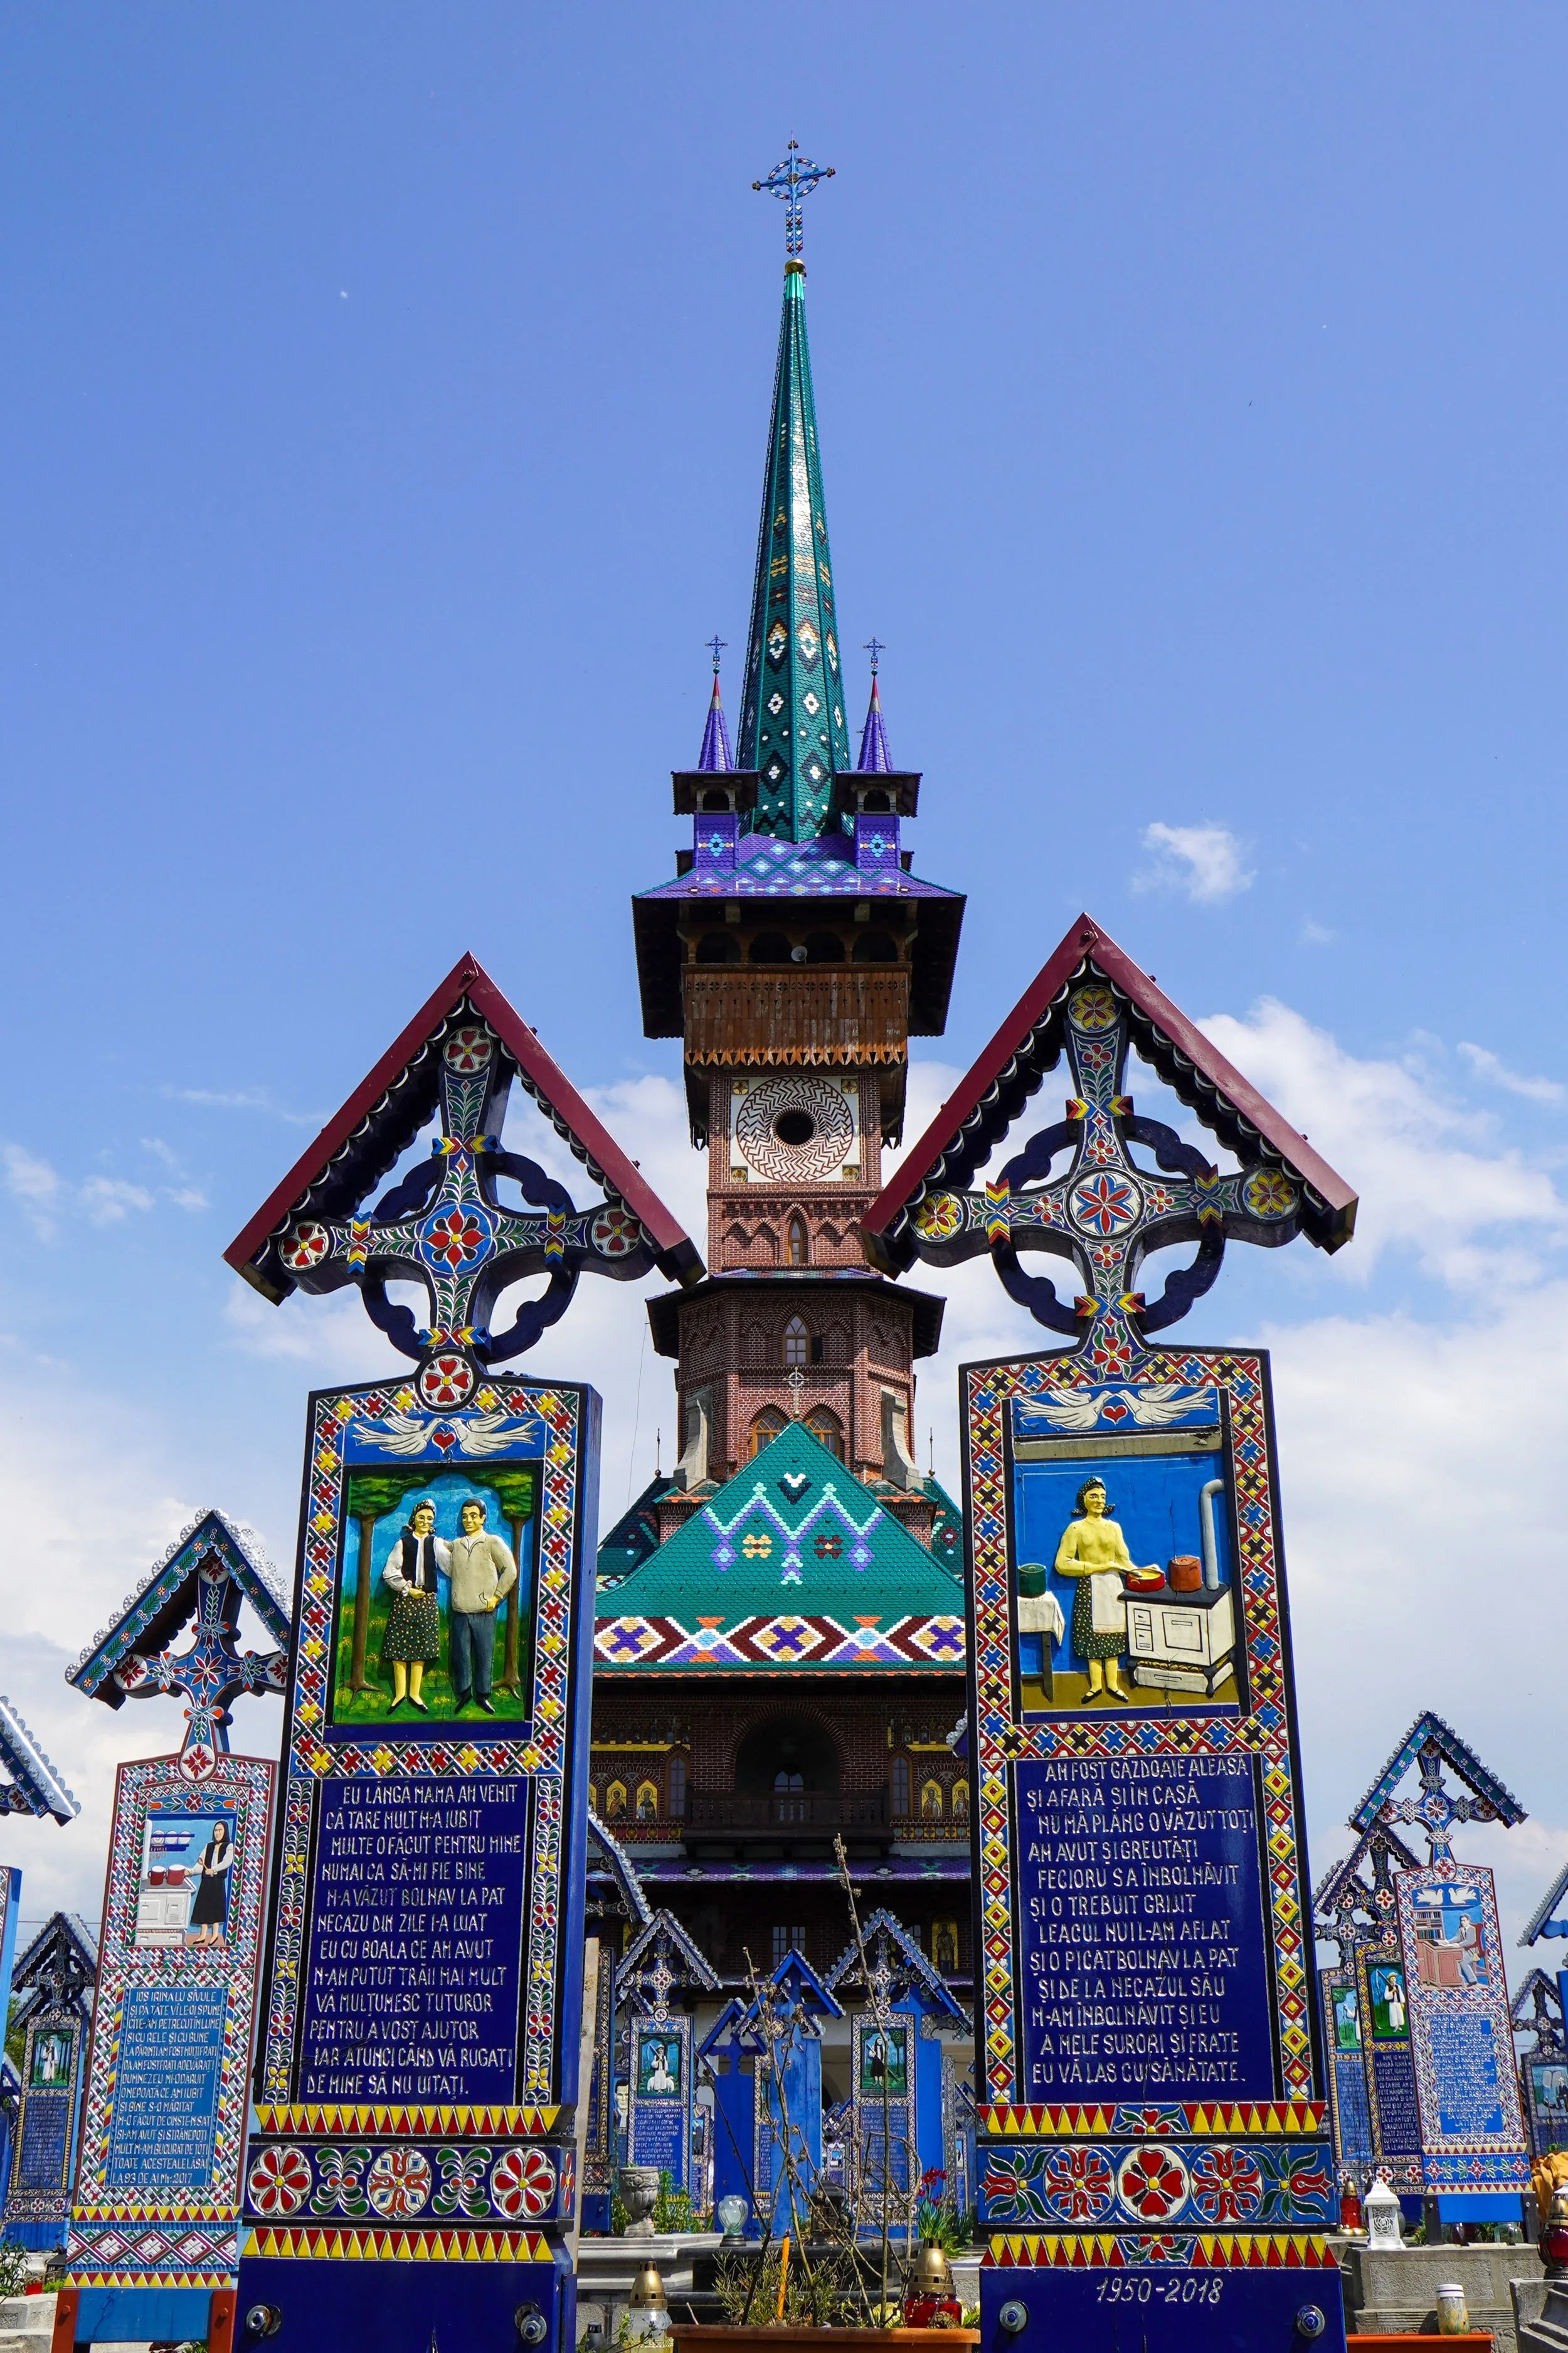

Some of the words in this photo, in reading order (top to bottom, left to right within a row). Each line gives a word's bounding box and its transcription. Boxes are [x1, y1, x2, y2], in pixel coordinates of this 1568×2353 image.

[1045, 1762, 1067, 1782] AM
[1072, 1761, 1107, 1781] FOST
[344, 1786, 361, 1805] EU
[415, 1785, 455, 1803] MAMA
[457, 1784, 475, 1803] AM
[480, 1784, 517, 1802] VENIT
[1153, 1780, 1200, 1805] CASĂ
[326, 1807, 344, 1829] CĂ
[348, 1811, 381, 1829] TARE
[384, 1810, 418, 1829] MULT
[420, 1810, 443, 1828] M-A
[446, 1810, 482, 1828] IUBIT
[1037, 1814, 1060, 1834] NU
[1064, 1810, 1089, 1834] MĂ
[1162, 1807, 1216, 1830] VĂZUT
[1218, 1809, 1254, 1833] TOȚI
[331, 1837, 374, 1856] MULTE
[388, 1832, 431, 1854] FĂCUT
[435, 1835, 485, 1854] PENTRU
[489, 1834, 521, 1854] MINE
[1027, 1842, 1052, 1862] AM
[1055, 1842, 1098, 1861] AVUT
[1102, 1841, 1118, 1864] ȘI
[322, 1862, 363, 1881] NUMAI
[367, 1862, 384, 1881] CA
[432, 1861, 451, 1880] FIE
[455, 1862, 485, 1880] BINE
[1038, 1867, 1106, 1889] FECIORU
[402, 1888, 456, 1906] BOLNAV
[461, 1887, 478, 1906] LA
[481, 1887, 506, 1906] PAT
[1068, 1894, 1138, 1916] TREBUIT
[317, 1914, 368, 1933] NECAZU
[373, 1914, 394, 1932] DIN
[399, 1914, 426, 1932] ZILE
[453, 1913, 488, 1932] LUAT
[1039, 1923, 1101, 1943] LEACUL
[1180, 1920, 1231, 1941] AFLAT
[320, 1940, 337, 1959] EU
[341, 1940, 358, 1958] CU
[362, 1940, 408, 1959] BOALA
[411, 1940, 428, 1958] CE
[432, 1940, 452, 1958] AM
[455, 1939, 494, 1959] AVUT
[1066, 1950, 1115, 1970] PICAT
[1117, 1949, 1180, 1971] BOLNAV
[1183, 1948, 1205, 1968] LA
[1209, 1947, 1239, 1968] PAT
[314, 1967, 348, 1985] N-AM
[351, 1967, 396, 1985] PUTUT
[440, 1967, 464, 1985] MAI
[469, 1967, 507, 1985] MULT
[1059, 1978, 1079, 1999] DE
[1085, 1977, 1106, 1998] LA
[1111, 1976, 1187, 1998] NECAZUL
[1190, 1972, 1225, 1996] SĂU
[425, 1993, 494, 2012] TUTUROR
[1032, 2005, 1073, 2027] M-AM
[1199, 2004, 1219, 2024] EU
[309, 2019, 364, 2040] PENTRU
[421, 2020, 479, 2040] AJUTOR
[1059, 2034, 1099, 2054] MELE
[1103, 2033, 1164, 2054] SURORI
[1189, 2032, 1239, 2053] FRATE
[314, 2047, 339, 2066] IAR
[344, 2047, 395, 2067] ATUNCI
[438, 2042, 457, 2067] VĂ
[460, 2047, 512, 2072] RUGAȚI
[122, 2073, 164, 2084] DUMNEZEU
[1032, 2063, 1053, 2083] EU
[1057, 2058, 1083, 2083] VĂ
[1086, 2062, 1117, 2083] LAS
[1121, 2062, 1144, 2083] CU
[307, 2073, 326, 2093] DE
[329, 2073, 364, 2094] MINE
[368, 2071, 388, 2095] SĂ
[391, 2075, 412, 2095] NU
[114, 2157, 139, 2169] TOATE
[124, 2172, 136, 2184] 93
[1096, 2277, 1224, 2303] 1950-2018
